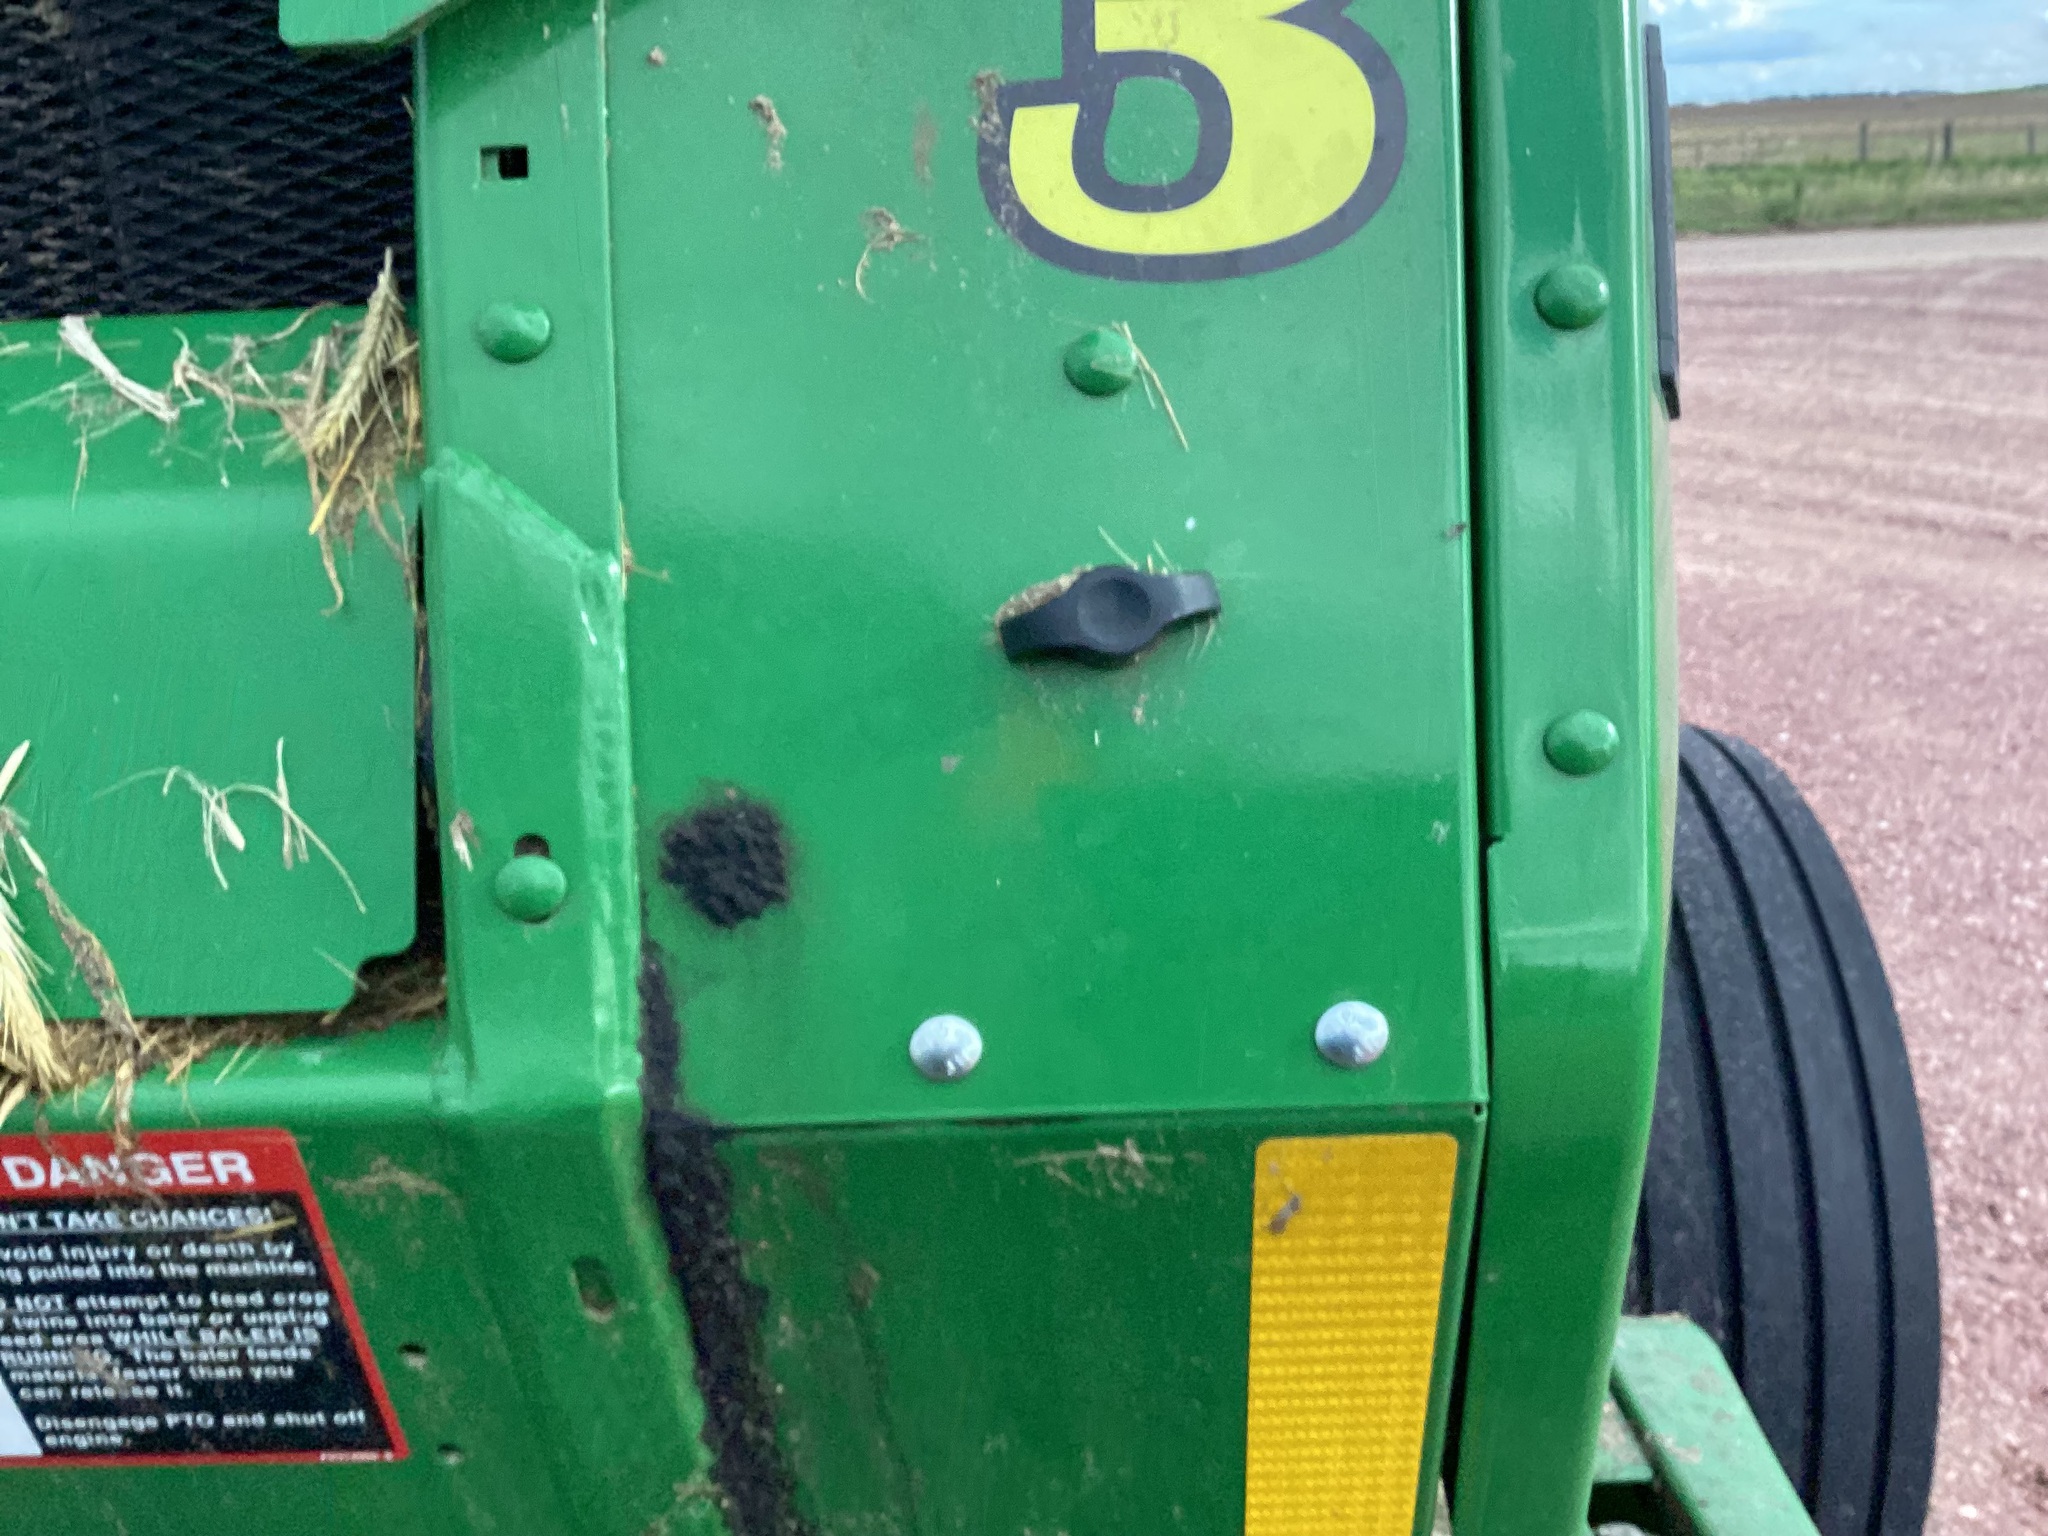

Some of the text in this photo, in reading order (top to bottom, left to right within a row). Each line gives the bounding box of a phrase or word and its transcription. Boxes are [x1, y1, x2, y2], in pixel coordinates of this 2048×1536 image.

[1, 1150, 255, 1190] DANGER
[46, 1210, 124, 1231] TAKE
[128, 1206, 274, 1229] CHANCES!
[59, 1242, 136, 1263] injury
[145, 1244, 171, 1259] or
[181, 1241, 256, 1259] death
[262, 1239, 294, 1258] by
[27, 1262, 101, 1284] pulled
[105, 1263, 154, 1279] into
[158, 1261, 199, 1279] the
[14, 1294, 64, 1313] NOT
[75, 1294, 169, 1311] attempt
[176, 1291, 202, 1308] to
[209, 1289, 264, 1308] feed
[272, 1290, 330, 1308] crop
[12, 1314, 78, 1330] twine
[83, 1313, 133, 1329] into
[138, 1311, 200, 1328] baler
[208, 1311, 234, 1327] or
[242, 1308, 329, 1328] unplug
[51, 1333, 104, 1347] area
[107, 1330, 193, 1348] WHILE
[198, 1327, 288, 1346] BALER
[292, 1326, 321, 1344] IS
[0, 1349, 120, 1368] RUNNIG.
[179, 1346, 239, 1362] baler
[246, 1345, 312, 1361] feeds
[9, 1369, 105, 1383] materia
[189, 1364, 243, 1380] than
[249, 1364, 294, 1382] you
[19, 1386, 63, 1400] can
[164, 1382, 192, 1398] it.
[34, 1409, 366, 1432] Disengage PTO and shut off
